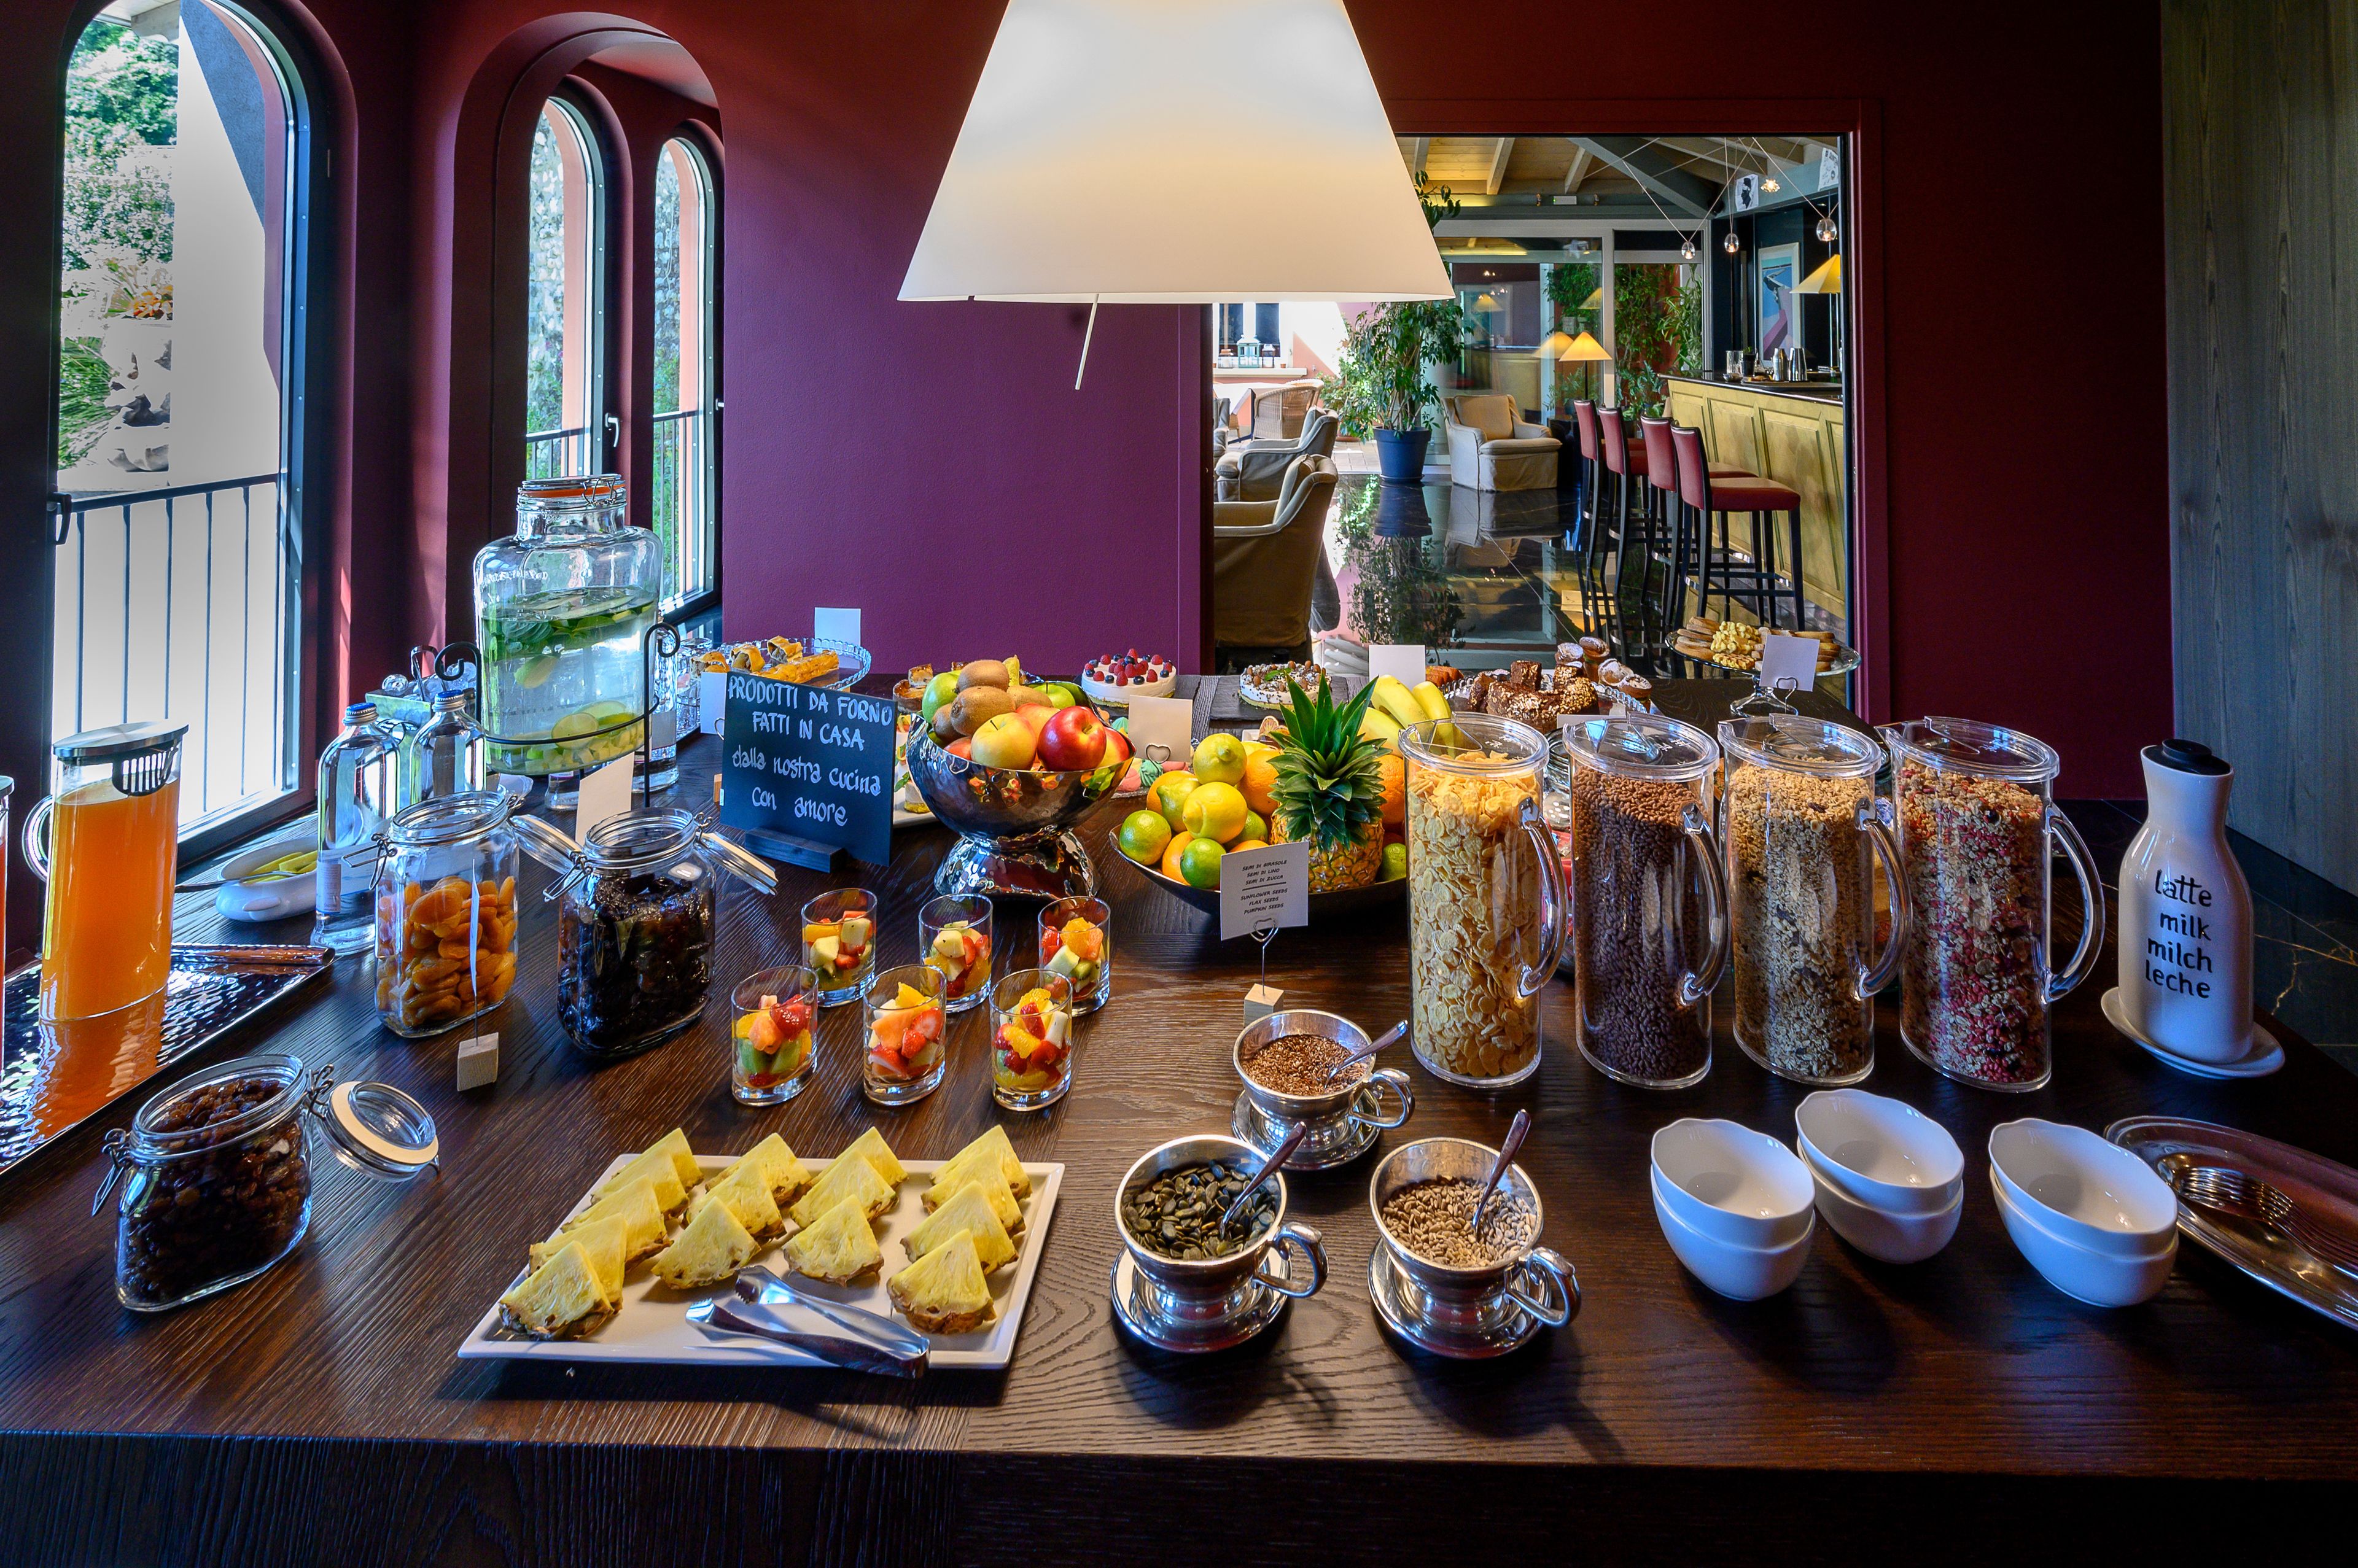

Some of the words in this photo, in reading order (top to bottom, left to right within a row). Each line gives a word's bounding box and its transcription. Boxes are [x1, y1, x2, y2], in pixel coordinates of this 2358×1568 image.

[728, 675, 798, 708] PRODOTTI
[809, 691, 828, 713] DA
[837, 696, 893, 726] FORNO
[752, 711, 790, 735] FATTI
[799, 718, 812, 740] IN
[820, 723, 865, 751] CASA
[732, 744, 766, 770] dalla
[773, 756, 822, 783] nostra
[829, 767, 881, 796] cucina
[794, 797, 848, 826] amore
[1240, 890, 1270, 901] SUNFLOWER
[2155, 869, 2212, 907] latte
[1243, 906, 1267, 915] PUMPKIN
[2160, 912, 2211, 941] milk
[2148, 937, 2213, 973] milch
[2145, 959, 2211, 998] leche
